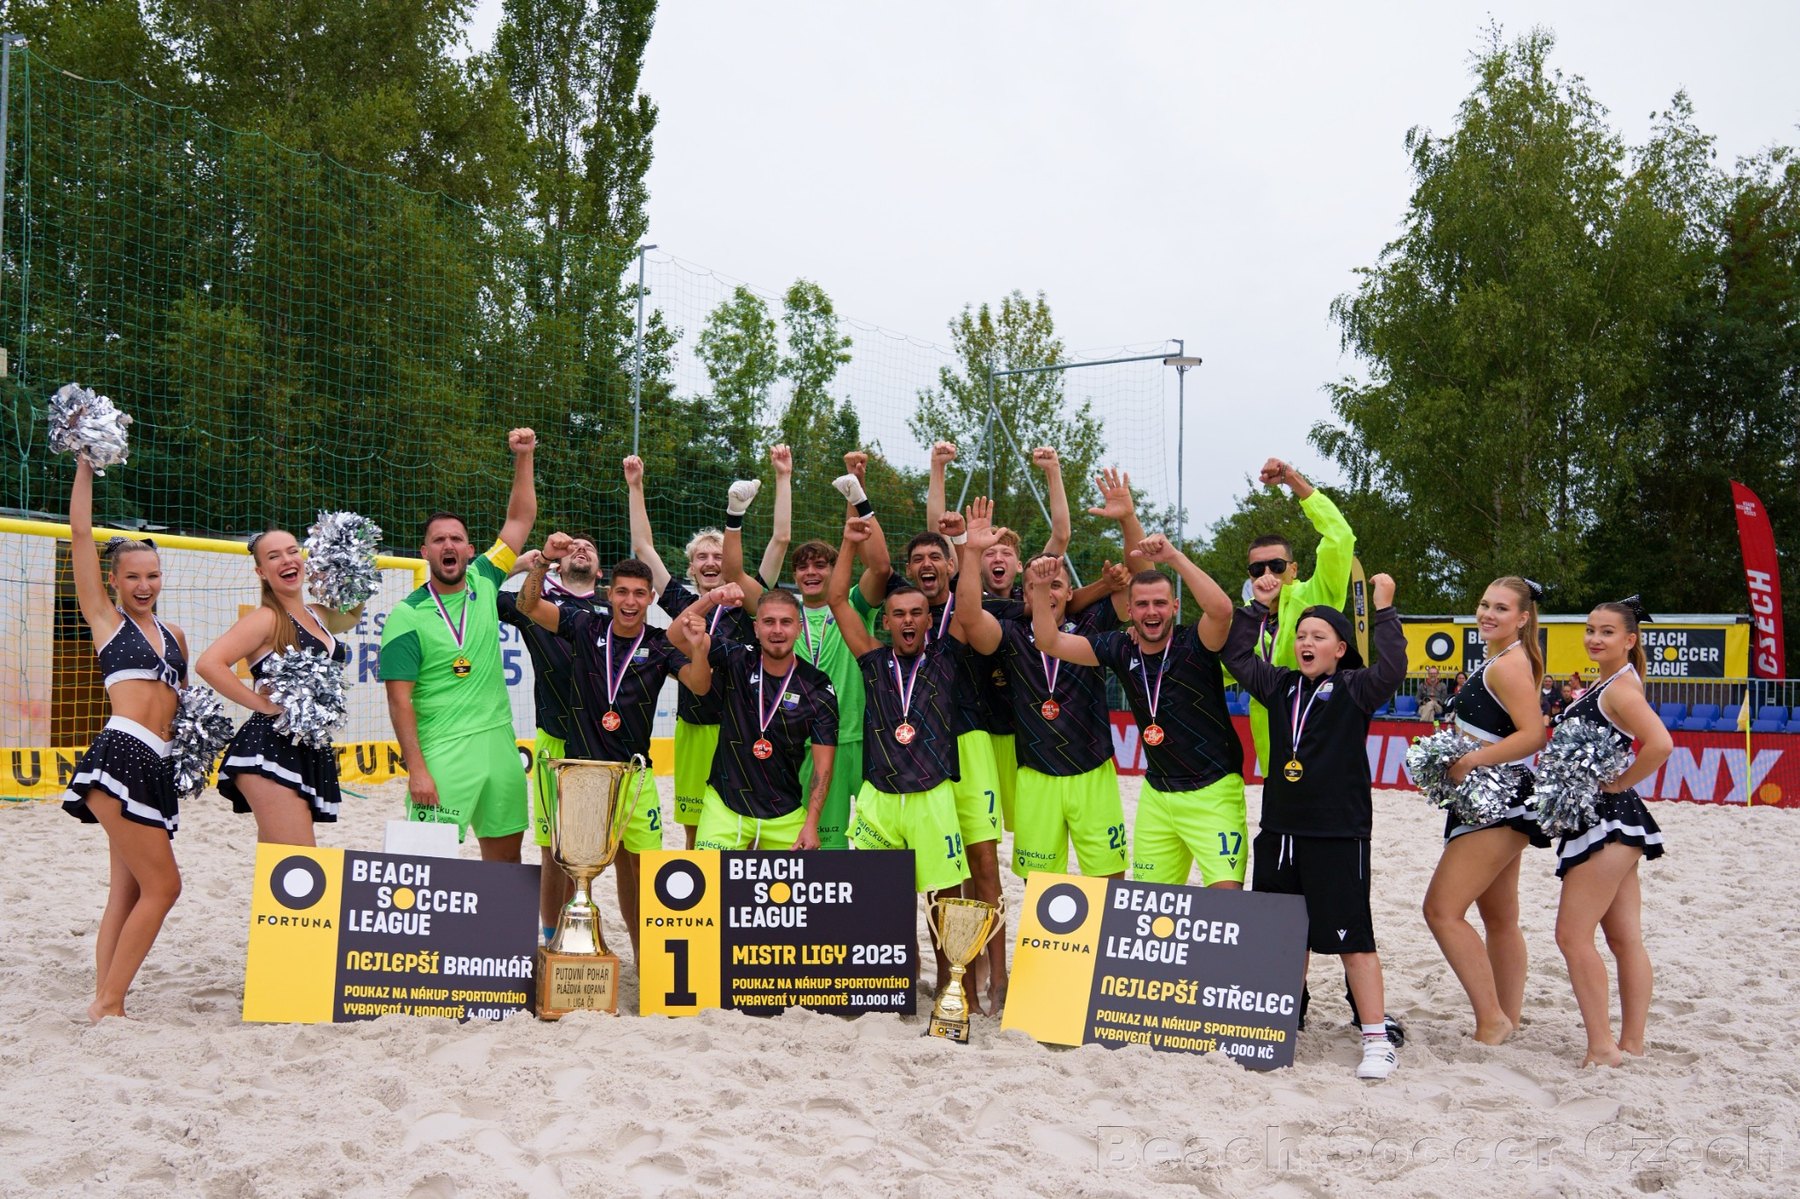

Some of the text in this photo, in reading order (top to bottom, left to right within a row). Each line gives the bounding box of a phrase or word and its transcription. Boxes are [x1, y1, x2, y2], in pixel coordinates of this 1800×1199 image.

[1653, 647, 1719, 662] SOCCER
[1645, 662, 1689, 676] EAGUE
[984, 790, 995, 814] 7
[647, 807, 662, 831] 2
[944, 832, 962, 859] 18
[1217, 831, 1243, 856] 17
[352, 859, 430, 886] BEACH
[729, 858, 804, 880] BEACH
[377, 886, 478, 914] SOCCER
[754, 882, 853, 904] SOCCER
[1113, 888, 1192, 916] BEACH
[257, 915, 332, 929] FORTUNA
[348, 909, 431, 936] LEAGUE
[646, 917, 714, 927] FORTUNA
[729, 906, 807, 928] LEAGUE
[1136, 914, 1240, 945] SOCCER
[732, 944, 907, 965] MISTR LIGY 2025
[1021, 938, 1090, 954] FORTUNA
[1106, 935, 1189, 965] LEAGUE
[346, 950, 533, 978] NEJLEPŠÍ BRANKÁŘ
[555, 965, 609, 981] PUTOVNÍ POHÁR
[665, 939, 697, 1006] 1
[732, 975, 910, 990] POUKAZ NA NÁKUP SPORTOVNÍHO
[344, 985, 527, 1005] POUKAZ NA NÁKUP SPORTOVNÍHO
[732, 992, 906, 1006] VYBAVENÍ V HODNOTĚ 10.000 KČ
[1100, 975, 1294, 1016] NEJLEPŠÍ STŘELEC
[1096, 1010, 1286, 1043] POUKAZ NA NÁKUP SPORTOVNÍHO
[1094, 1027, 1275, 1060] VYBAVENÍ V HODNOTĚ 4.000 KČ
